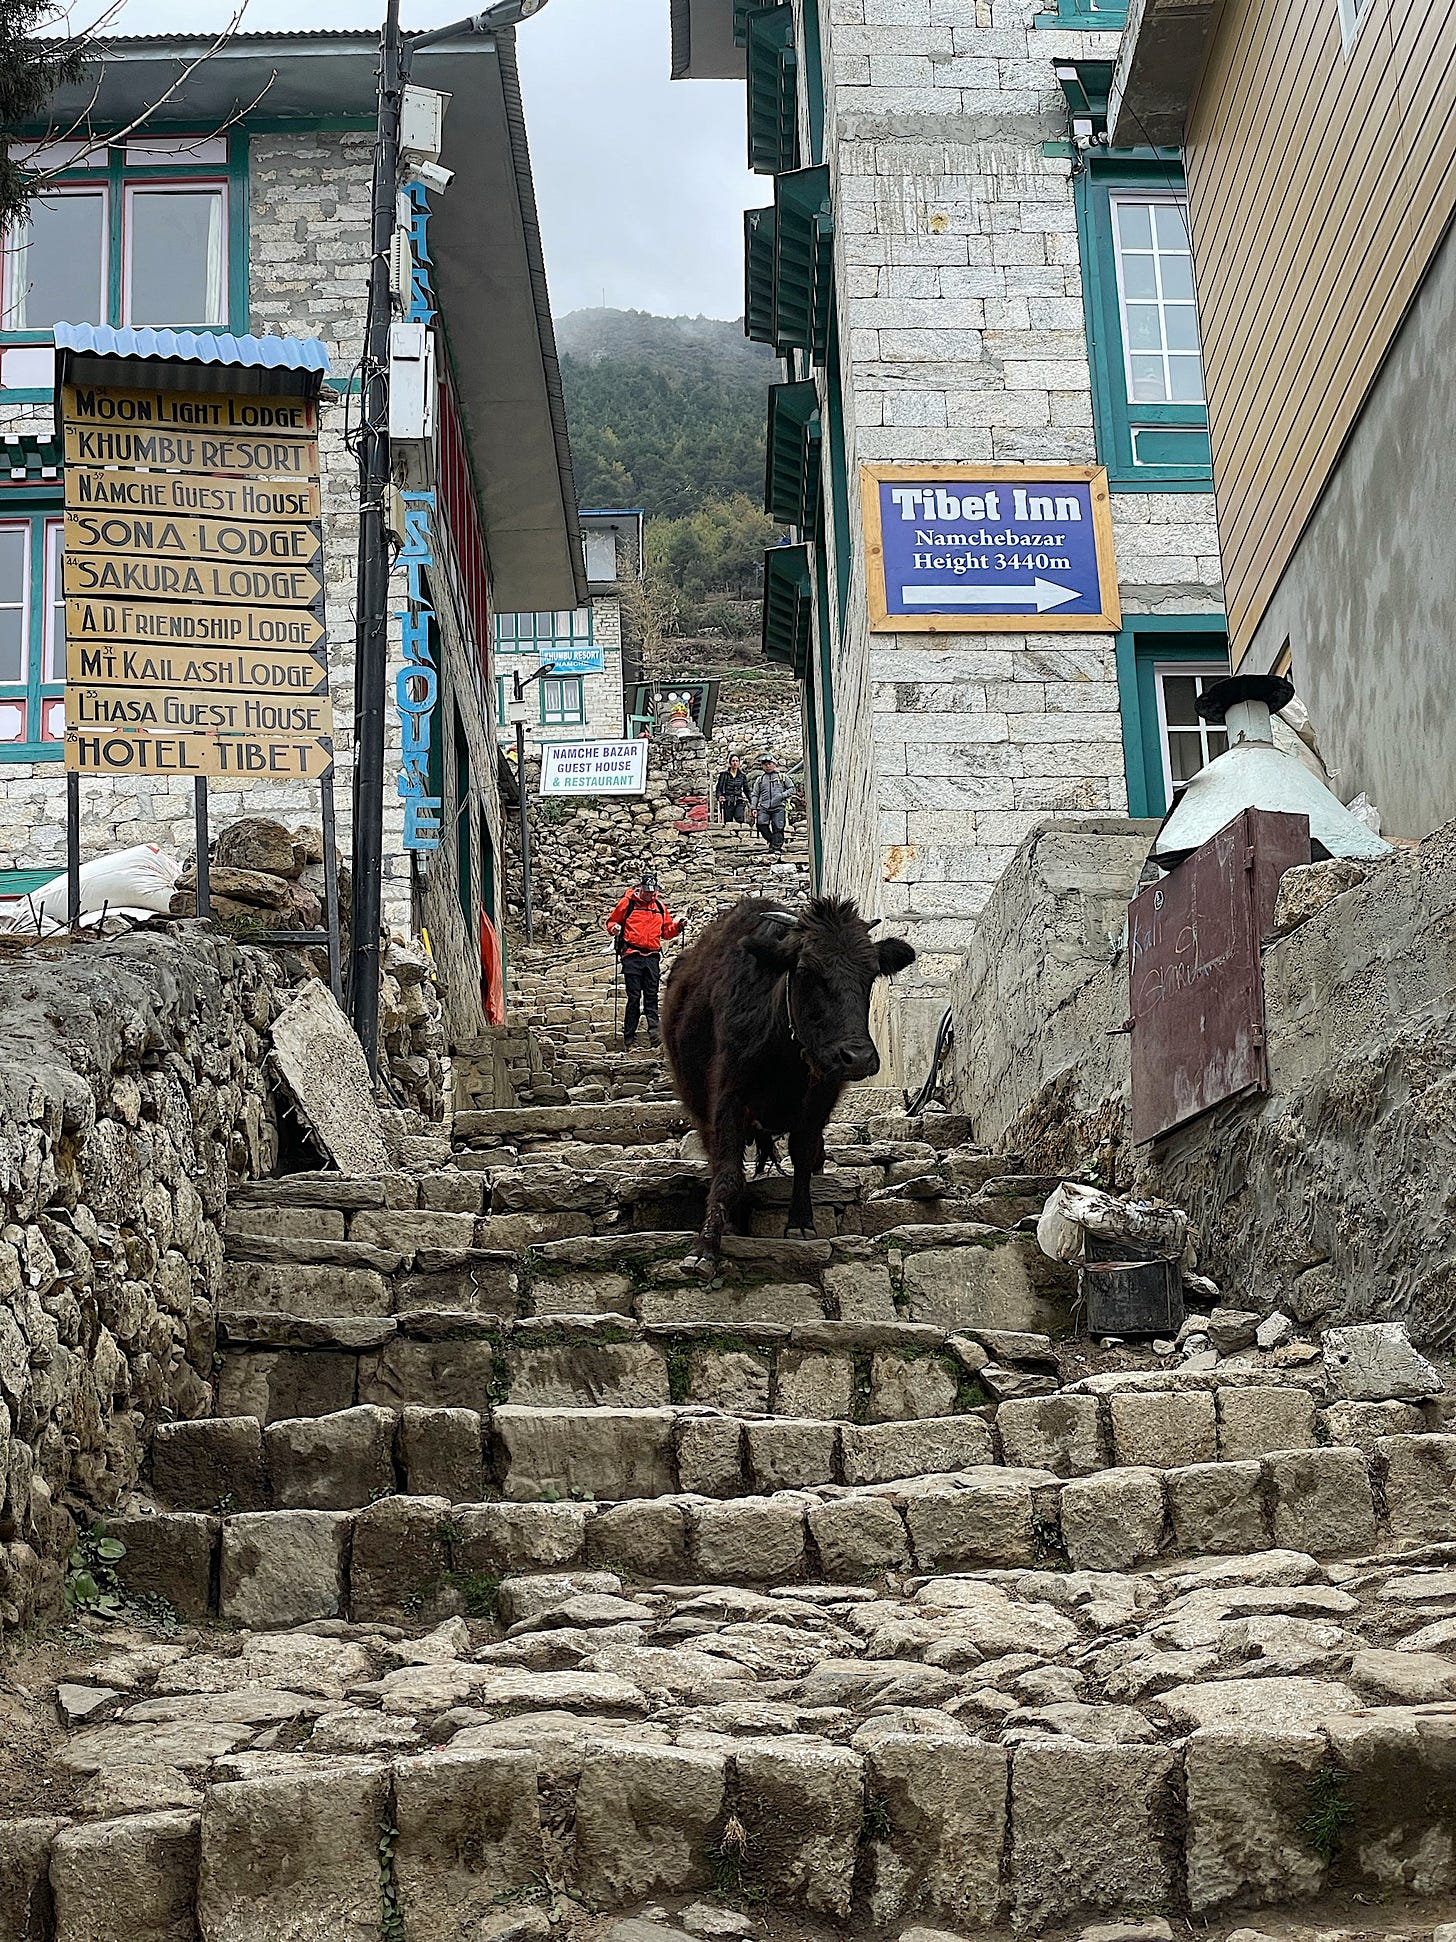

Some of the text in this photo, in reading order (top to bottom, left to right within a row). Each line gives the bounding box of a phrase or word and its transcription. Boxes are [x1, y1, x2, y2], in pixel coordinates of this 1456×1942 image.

[76, 389, 304, 429] MOON LIGHT LODGE
[79, 431, 305, 471] KHUMBU RESORT
[79, 474, 309, 515] NAMCHE GUEST HOUSE
[892, 488, 1082, 521] Tibet Inn
[78, 518, 308, 557] SONA LODGE
[914, 529, 1066, 546] Namchebazar
[78, 561, 309, 600] SAKURA LODGE
[913, 552, 1072, 574] Height 3440m
[122, 608, 242, 640] FRIENDSHIP
[248, 614, 313, 644] LODGE
[124, 651, 233, 683] KAILASH
[238, 657, 314, 687] LODGE
[574, 650, 600, 660] RESORT
[79, 692, 321, 731] LHASA GUEST HOUSE
[79, 737, 313, 772] HOTEL TIBET
[553, 746, 638, 759] NAMCHE BAZAR
[557, 761, 631, 773] GUEST HOUSE
[552, 775, 634, 787] & RESTAURANT
